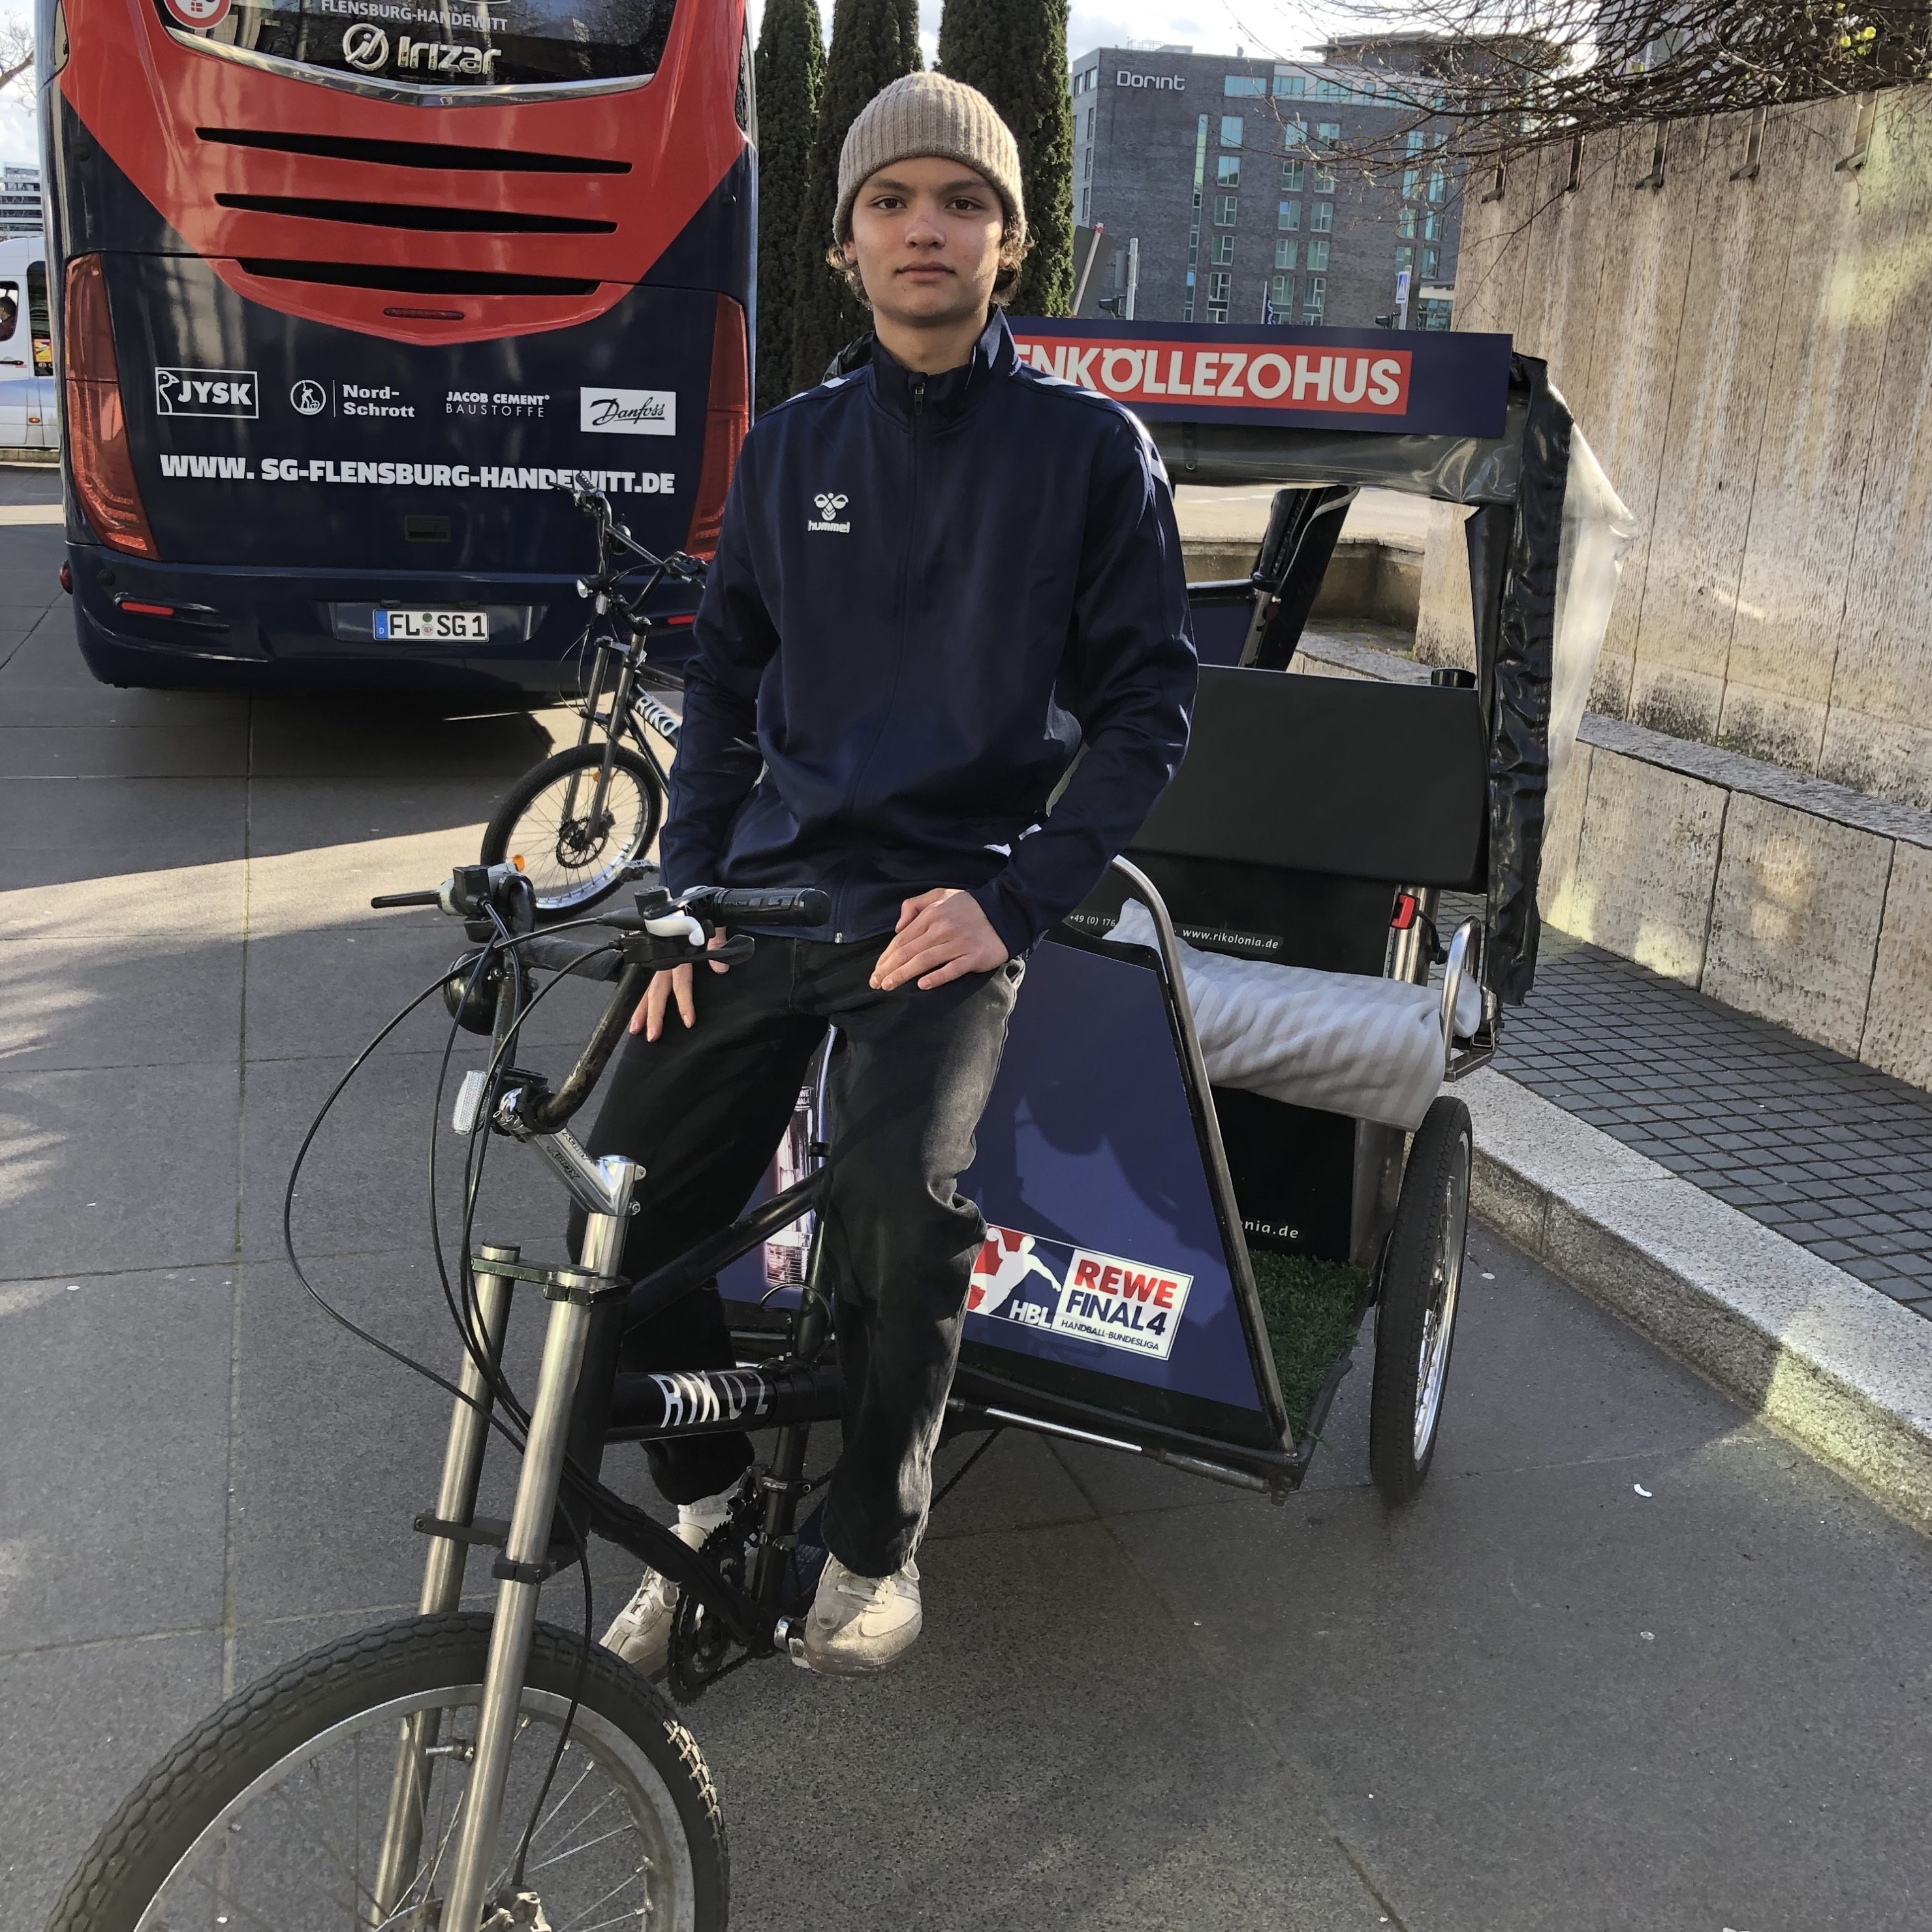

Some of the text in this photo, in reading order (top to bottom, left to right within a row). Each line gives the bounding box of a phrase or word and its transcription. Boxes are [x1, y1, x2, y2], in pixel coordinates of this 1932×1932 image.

[320, 0, 508, 31] FLENSBURG-HANDEWITT
[397, 36, 502, 74] Irizar
[1116, 70, 1186, 91] Dorint
[178, 380, 253, 405] JYSK
[342, 384, 400, 400] Nord-
[446, 391, 489, 403] JACOB
[343, 401, 416, 418] Schrott
[446, 403, 544, 418] BAUSTOFFE
[590, 396, 666, 426] Danfoss
[807, 520, 850, 533] hummel
[390, 614, 420, 636] FL
[1069, 914, 1085, 923] +49
[1086, 915, 1099, 926] (0)
[1182, 928, 1279, 950] www.rikolonia.de
[1240, 1220, 1299, 1239] nia.de
[1074, 1259, 1177, 1309] REWE
[1008, 1299, 1052, 1329] HBL
[1061, 1319, 1159, 1350] HANDBALL-BUNDESLIGA
